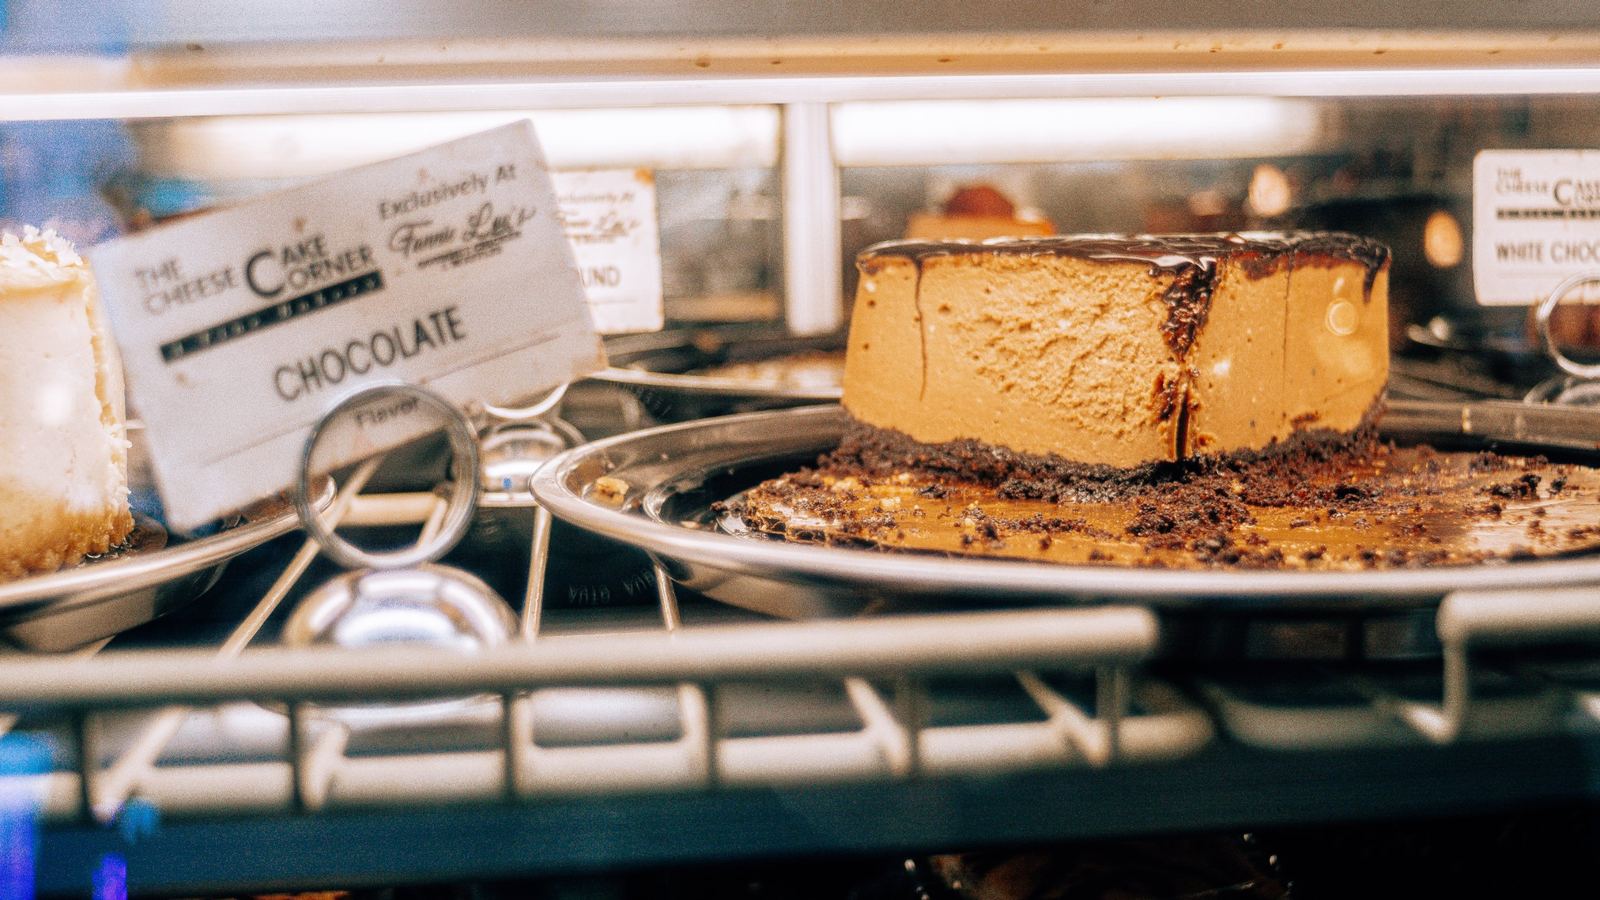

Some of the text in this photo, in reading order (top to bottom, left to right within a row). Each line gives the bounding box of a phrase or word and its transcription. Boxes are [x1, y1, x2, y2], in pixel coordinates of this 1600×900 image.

[379, 163, 516, 220] Exclusively At
[1496, 241, 1544, 262] WHITE
[134, 257, 179, 288] THE
[143, 266, 238, 314] CHEESE
[273, 305, 466, 401] CHOCOLATE
[355, 397, 420, 427] Flavor
